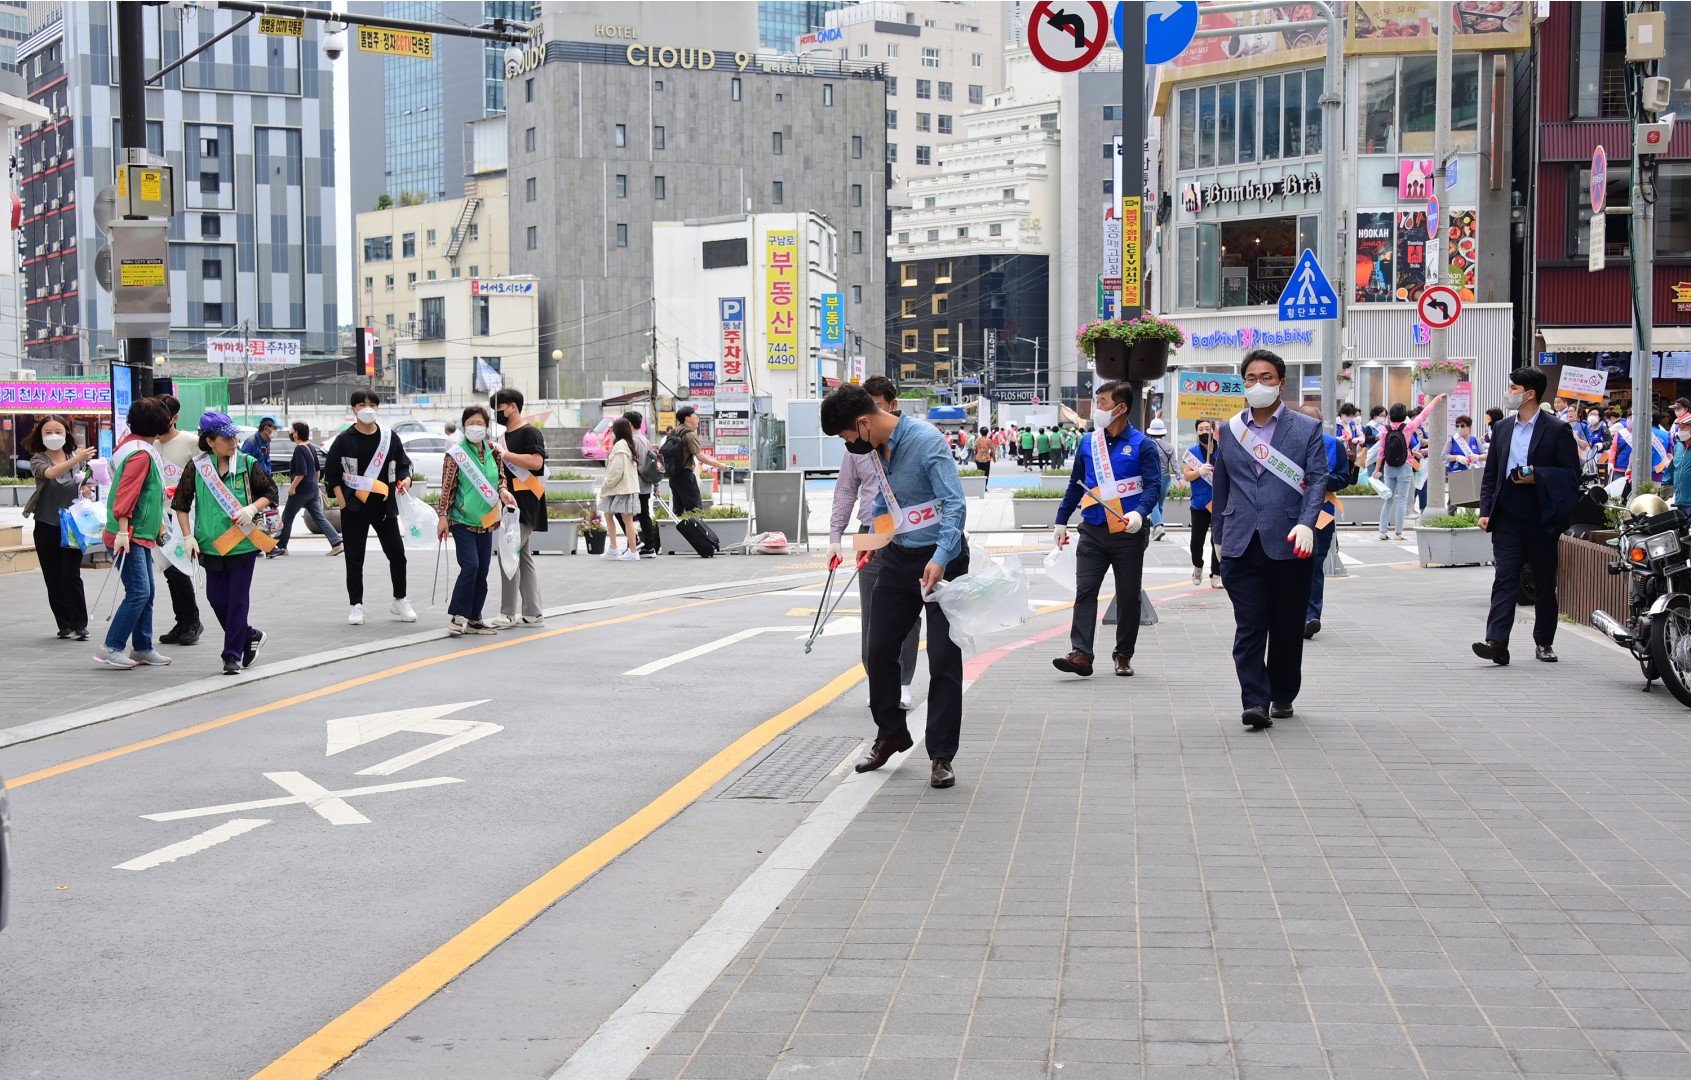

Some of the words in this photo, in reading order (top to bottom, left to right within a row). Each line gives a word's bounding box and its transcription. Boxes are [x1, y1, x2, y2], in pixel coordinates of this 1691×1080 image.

[1374, 8, 1392, 18] 인도
[1397, 6, 1416, 14] 요리
[261, 18, 276, 32] 방범용
[275, 20, 288, 33] CCTV
[288, 21, 302, 35] 작동중
[595, 24, 638, 39] HOTEL
[800, 35, 817, 45] HOTEL
[817, 28, 842, 43] ONDA
[626, 43, 716, 70] CLOUD
[734, 51, 750, 72] 9
[1205, 180, 1274, 207] Bombay
[1282, 172, 1323, 199] Brä
[767, 235, 795, 246] 구남로
[1358, 229, 1389, 239] HOOKAH
[1126, 243, 1137, 265] CCTV
[1359, 240, 1388, 255] Lounge
[480, 282, 524, 293] 어서오시다
[770, 251, 794, 335] 부동산
[723, 301, 741, 320] P
[825, 296, 840, 340] 부동산
[1287, 307, 1328, 318] 횡단보도
[723, 321, 742, 330] 동남
[1191, 330, 1235, 348] baskin
[1261, 328, 1312, 345] robbins
[267, 341, 298, 355] 주차장
[364, 332, 374, 363] P
[723, 330, 742, 375] 주차장
[767, 343, 795, 353] 744-
[767, 354, 795, 365] 4490
[1196, 380, 1220, 393] NO
[1221, 381, 1242, 393] 꽁초
[19, 387, 46, 403] 천사
[49, 387, 111, 404] 사주·타로
[1001, 391, 1016, 400] FLOS
[1016, 391, 1035, 400] HOTE
[1267, 455, 1302, 484] 담배꽁초
